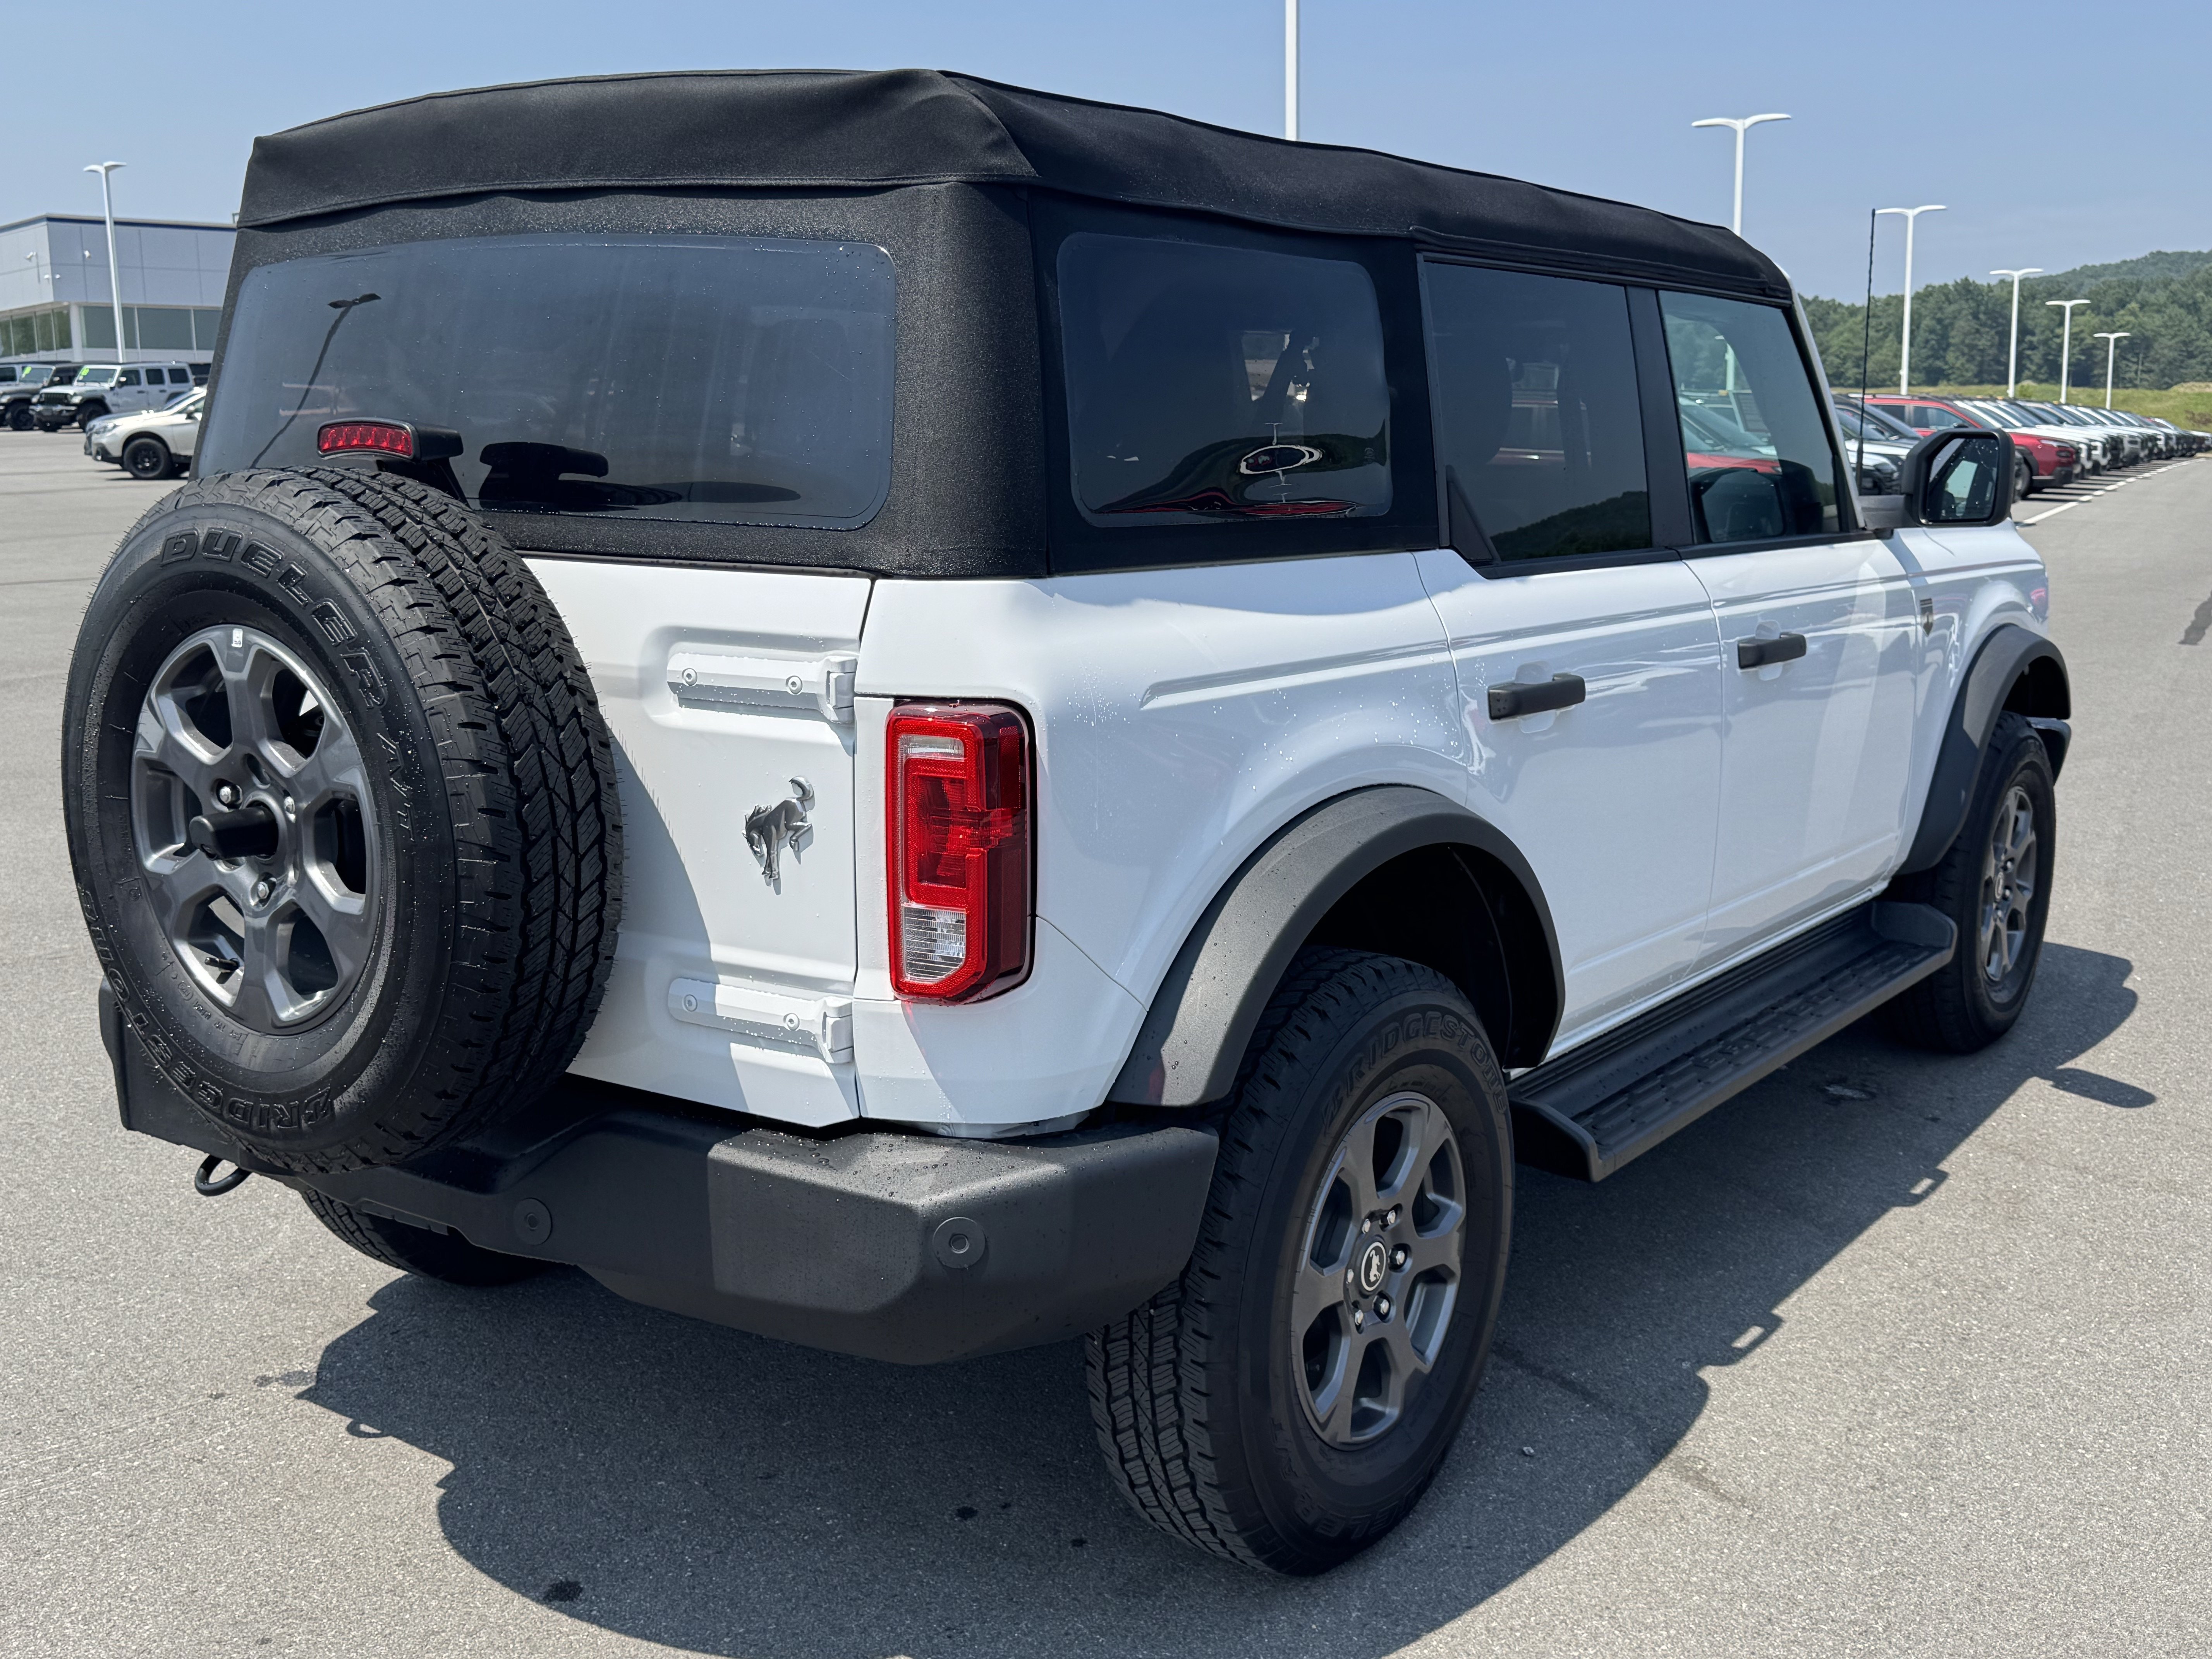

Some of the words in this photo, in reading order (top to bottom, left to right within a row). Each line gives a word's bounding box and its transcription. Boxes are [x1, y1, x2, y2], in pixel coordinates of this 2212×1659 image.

[160, 528, 388, 709] DUELER
[79, 885, 334, 1129] BRIDGESTONE
[1321, 1011, 1508, 1131] BRIDGESTONE
